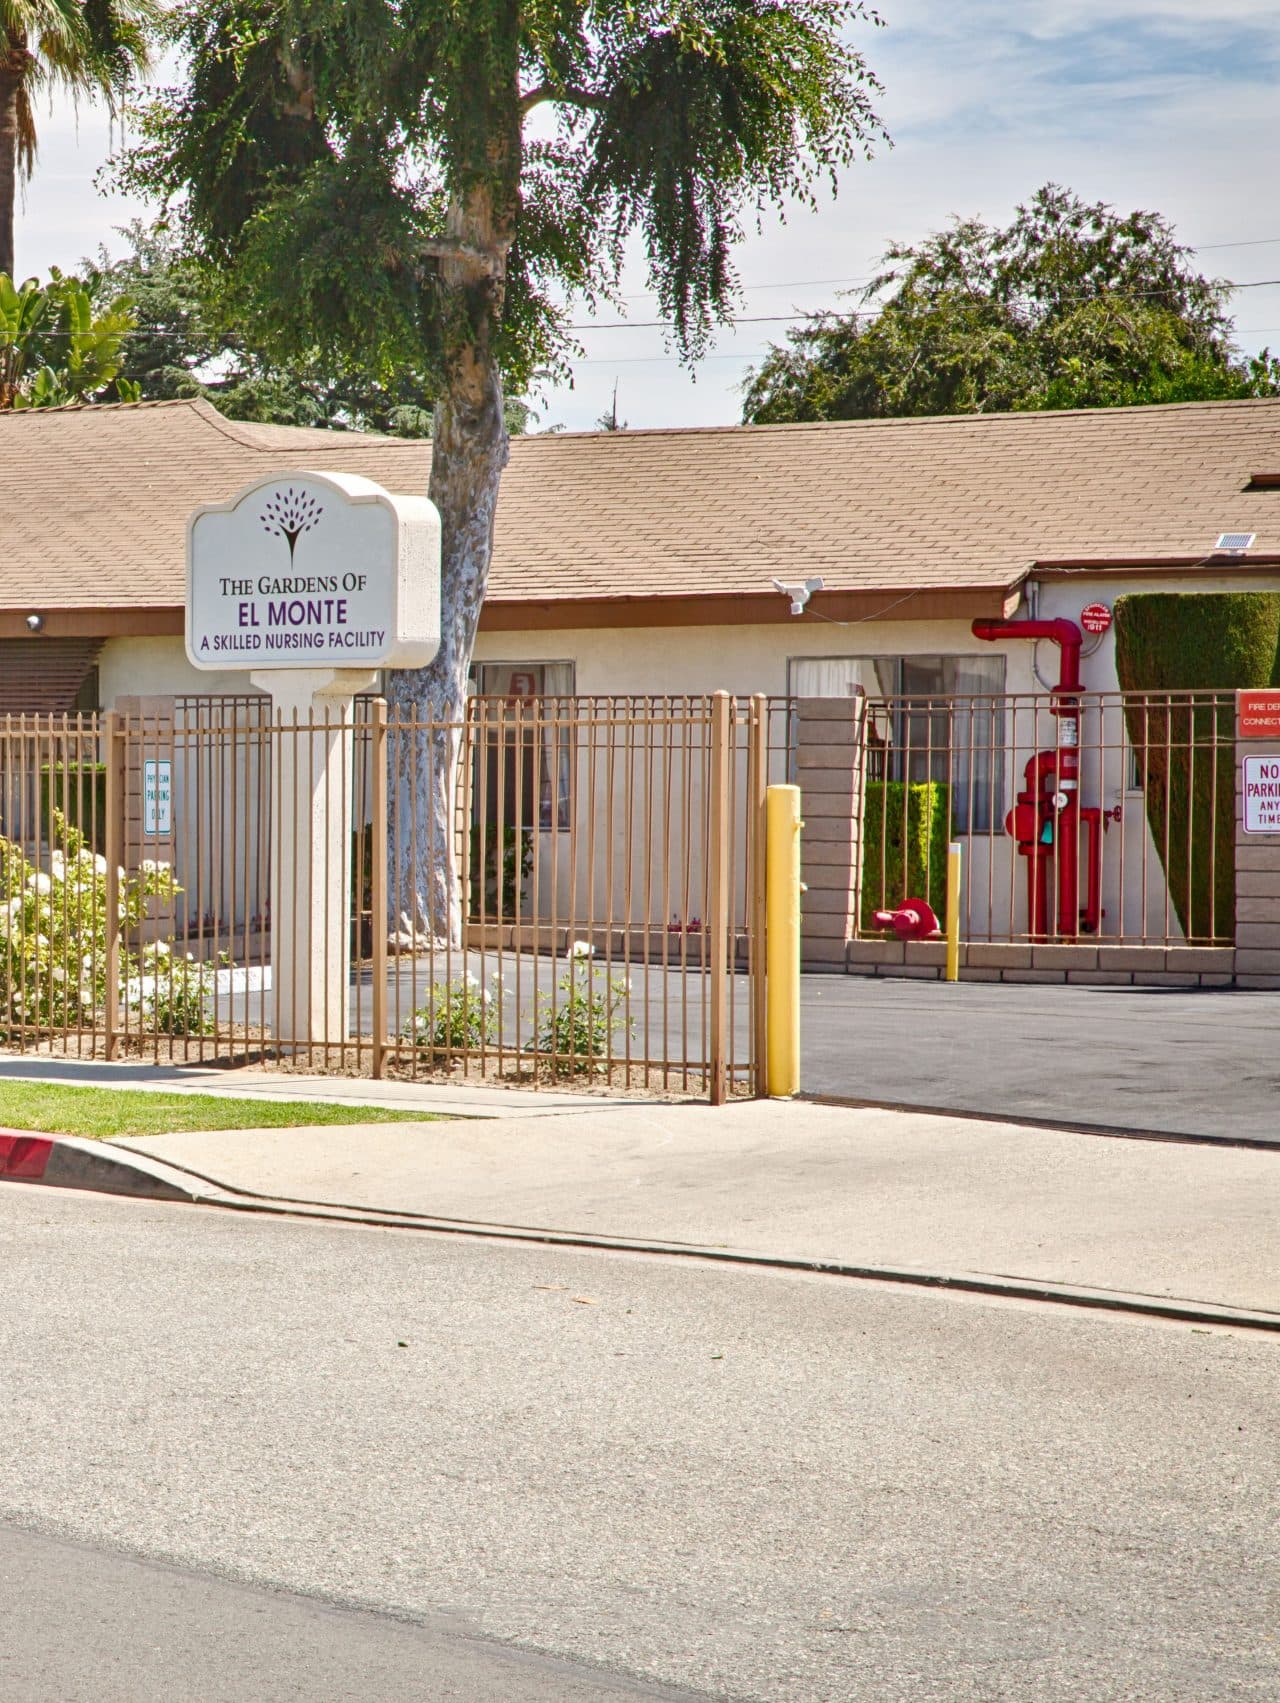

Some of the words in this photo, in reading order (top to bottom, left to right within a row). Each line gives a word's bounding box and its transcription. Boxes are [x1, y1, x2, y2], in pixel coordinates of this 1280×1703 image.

[239, 602, 260, 627] EL
[268, 599, 347, 626] MONTE
[200, 635, 210, 650] A
[213, 634, 262, 650] SKILLED
[265, 632, 325, 649] NURSING
[328, 631, 385, 648] FACILITY
[1248, 703, 1266, 711] FIRE
[1260, 764, 1279, 779] NO
[1247, 783, 1280, 797] PARKI
[1260, 801, 1279, 811] ANY
[151, 809, 166, 820] OLY
[1258, 814, 1280, 824] TIME
